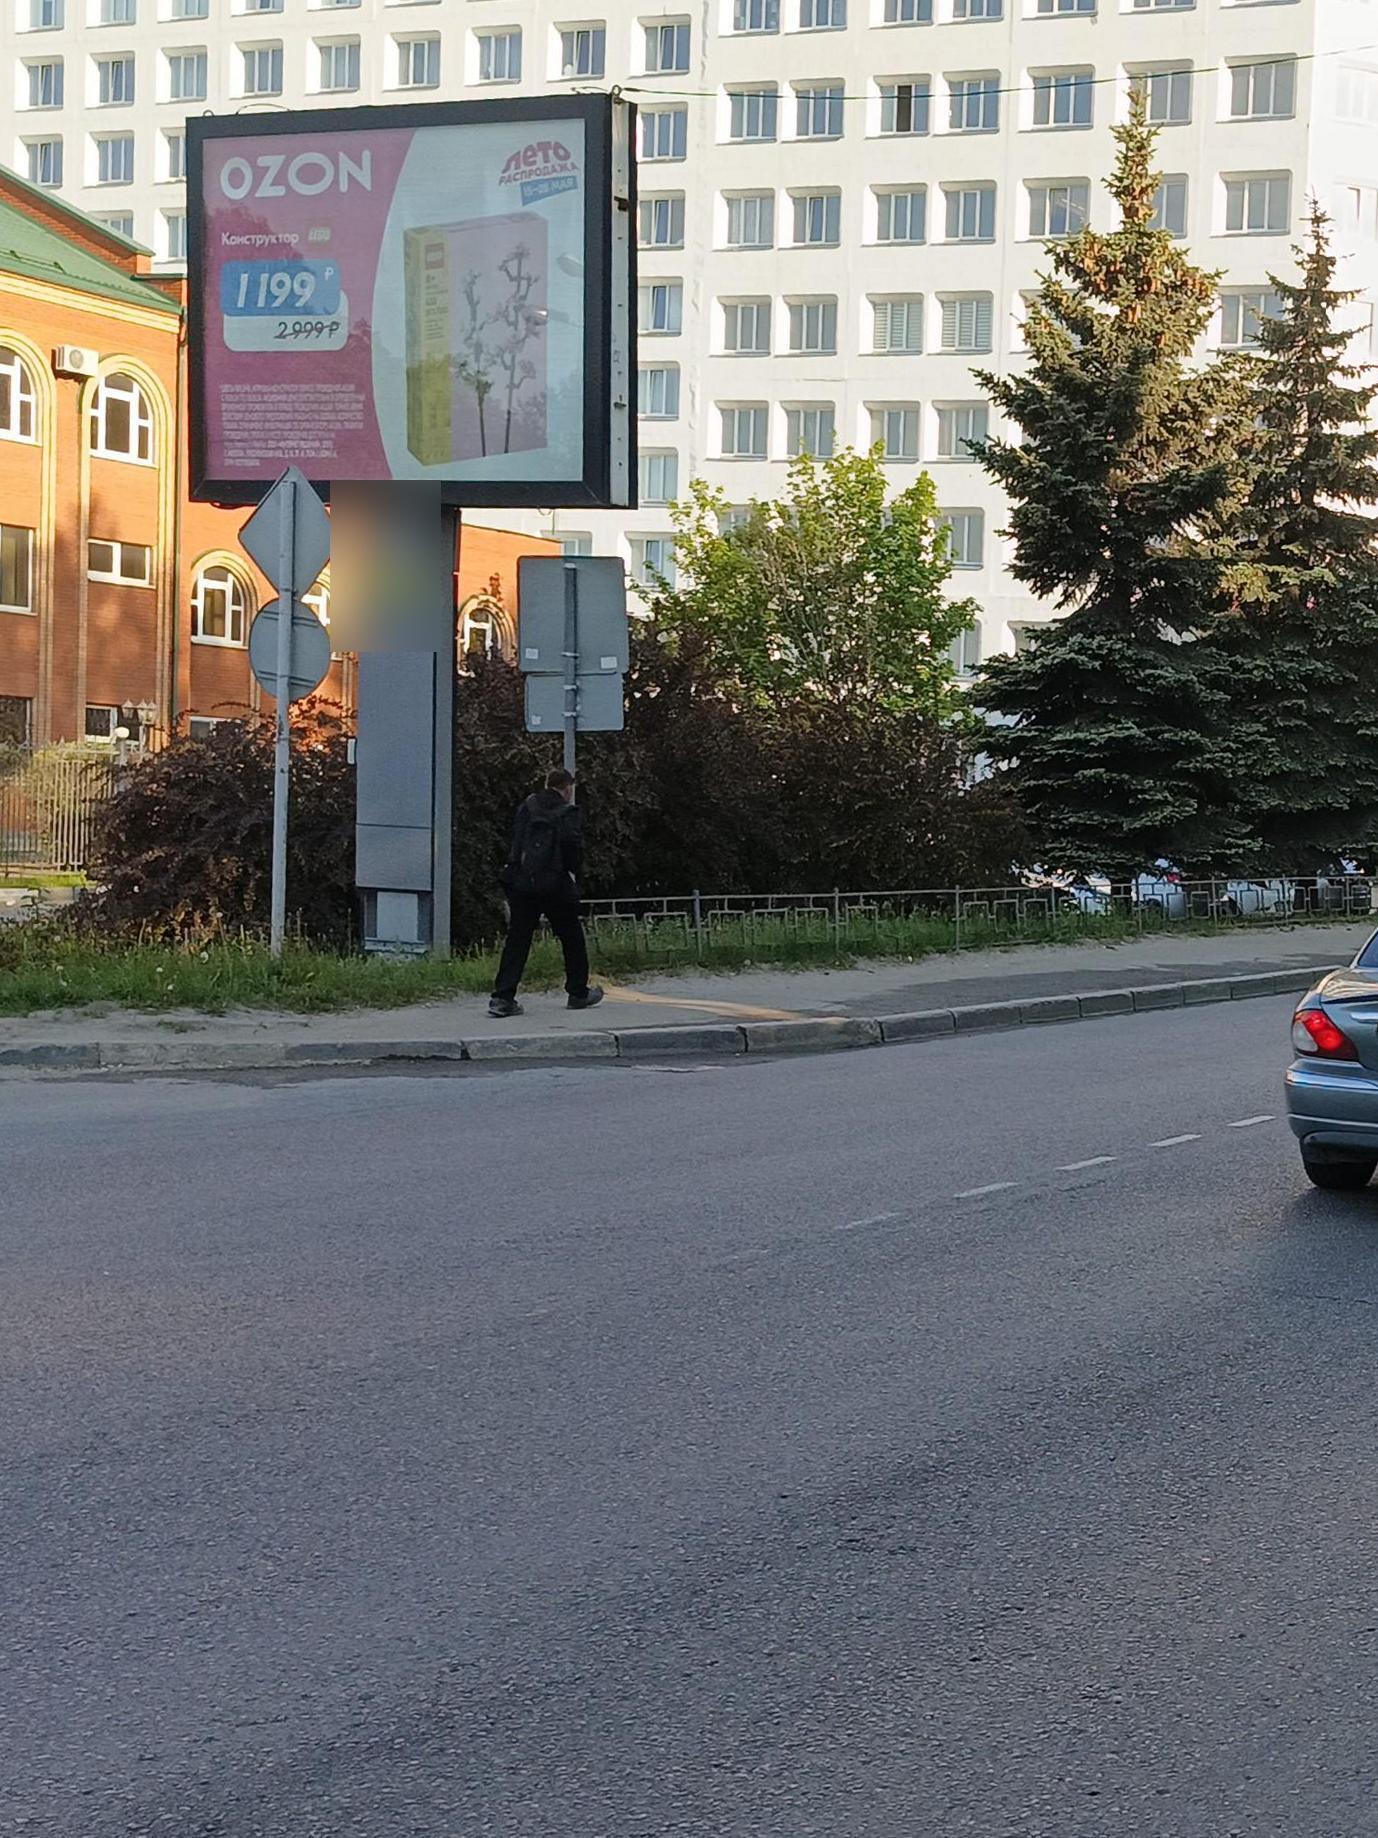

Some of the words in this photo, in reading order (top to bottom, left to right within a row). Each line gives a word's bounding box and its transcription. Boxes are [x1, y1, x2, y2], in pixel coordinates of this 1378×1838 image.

[220, 149, 372, 200] OZON
[499, 162, 581, 186] РАСПРОДАЖА
[221, 232, 300, 247] Конструктор
